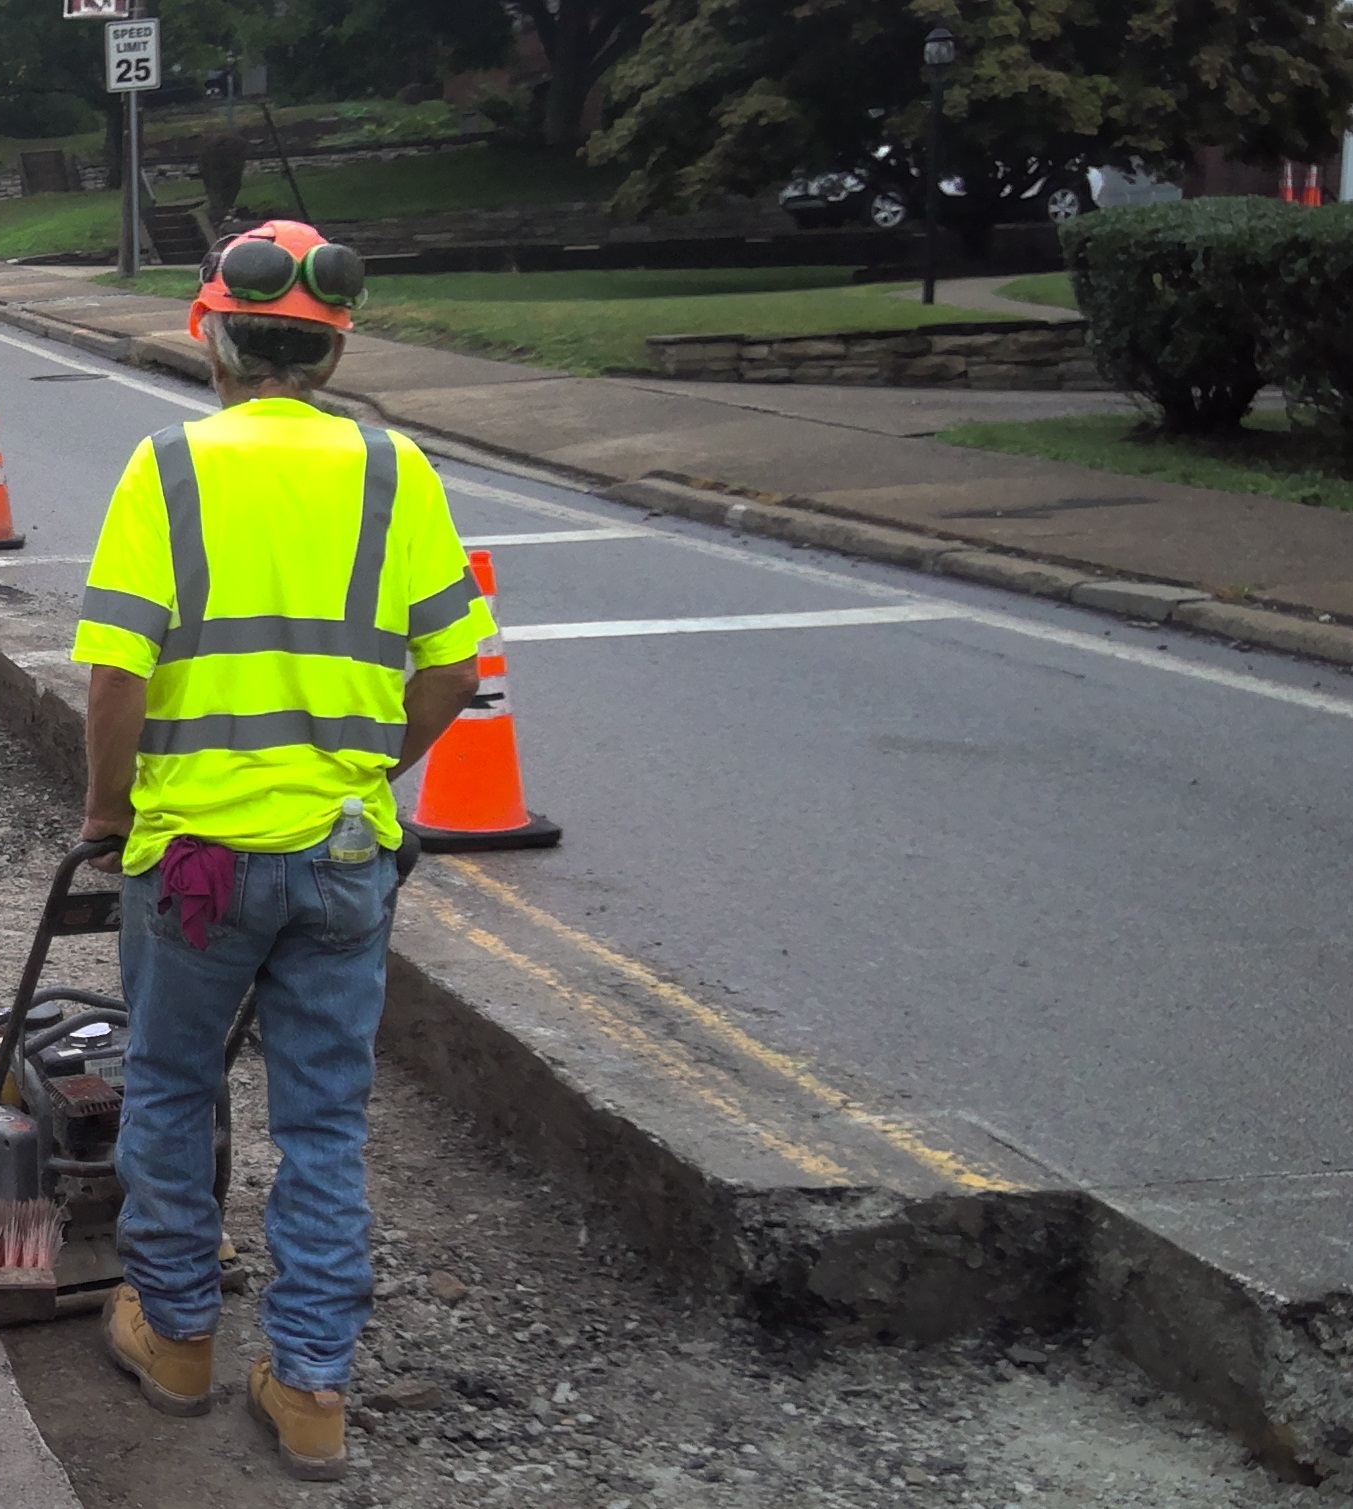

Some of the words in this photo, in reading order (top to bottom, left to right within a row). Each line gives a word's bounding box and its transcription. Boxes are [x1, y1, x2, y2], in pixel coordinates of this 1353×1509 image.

[112, 26, 152, 39] SPEED
[116, 41, 148, 53] LIMIT
[116, 58, 151, 83] 25
